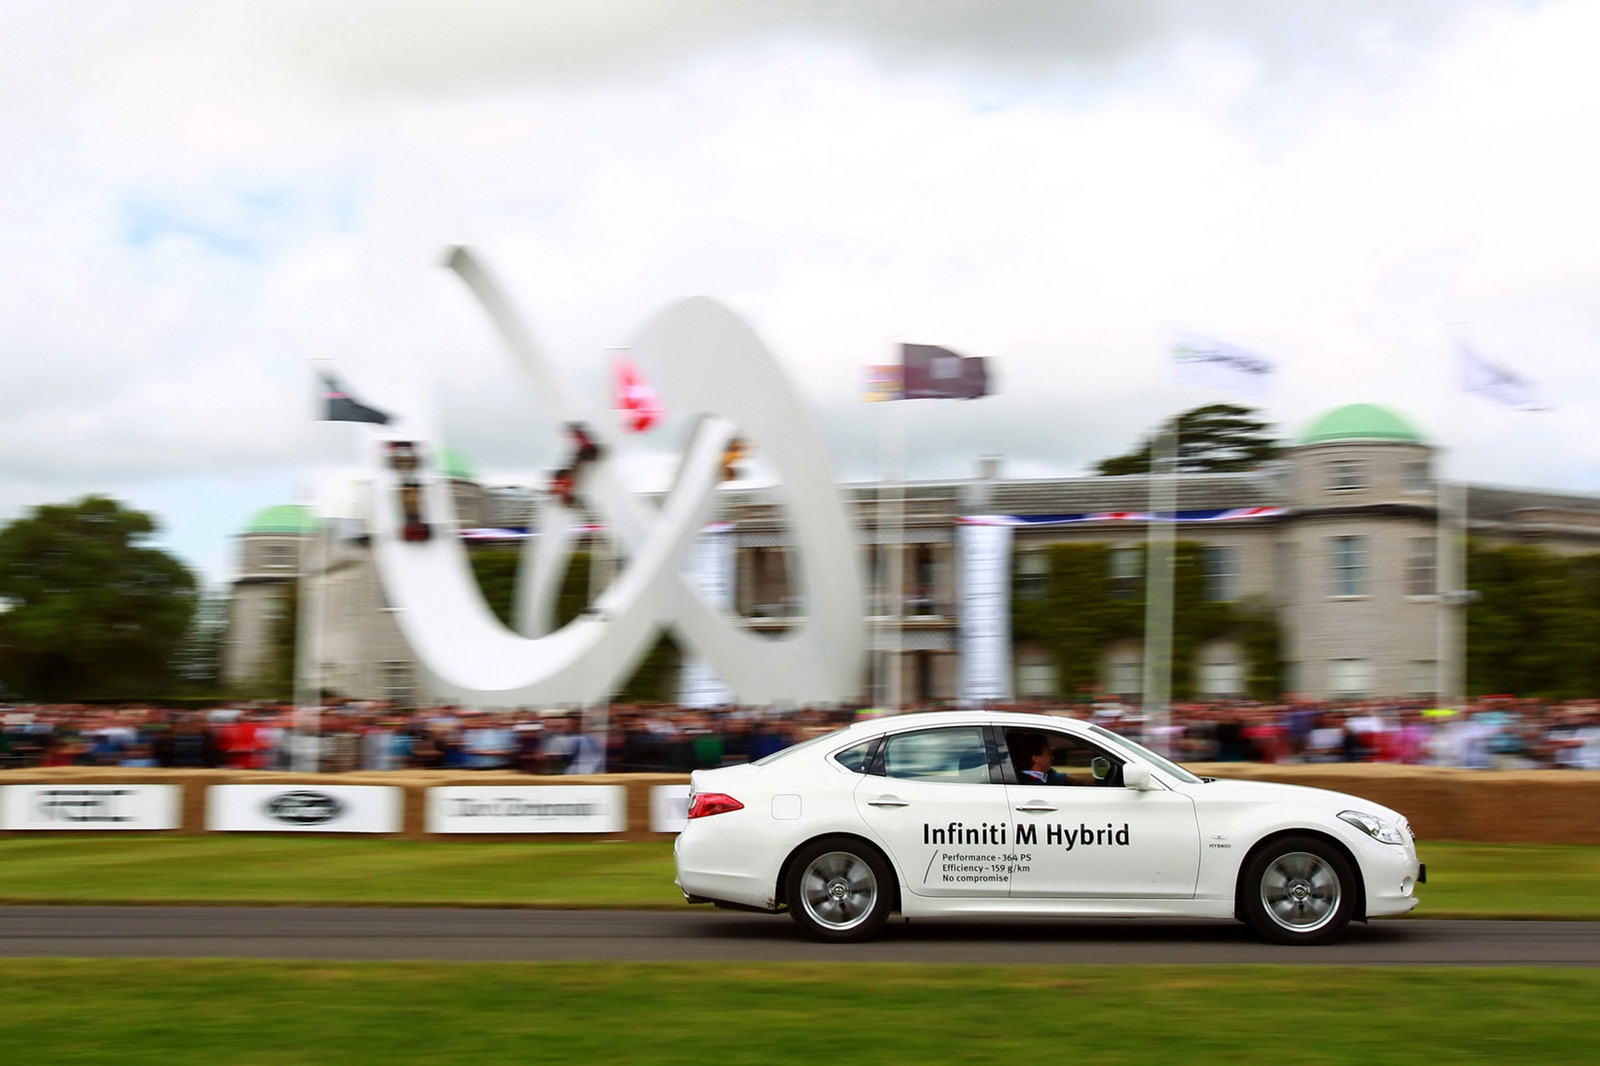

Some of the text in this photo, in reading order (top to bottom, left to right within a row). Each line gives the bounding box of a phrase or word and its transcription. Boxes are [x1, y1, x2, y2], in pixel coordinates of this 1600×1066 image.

[923, 822, 1130, 851] Infiniti M Hybrid
[942, 853, 996, 862] Performance
[1002, 853, 1018, 862] 364
[1020, 853, 1032, 862] PS
[942, 863, 984, 873] Efficiency
[991, 864, 1006, 872] 159
[1007, 864, 1031, 874] g/km
[942, 874, 1009, 883] No compromise
